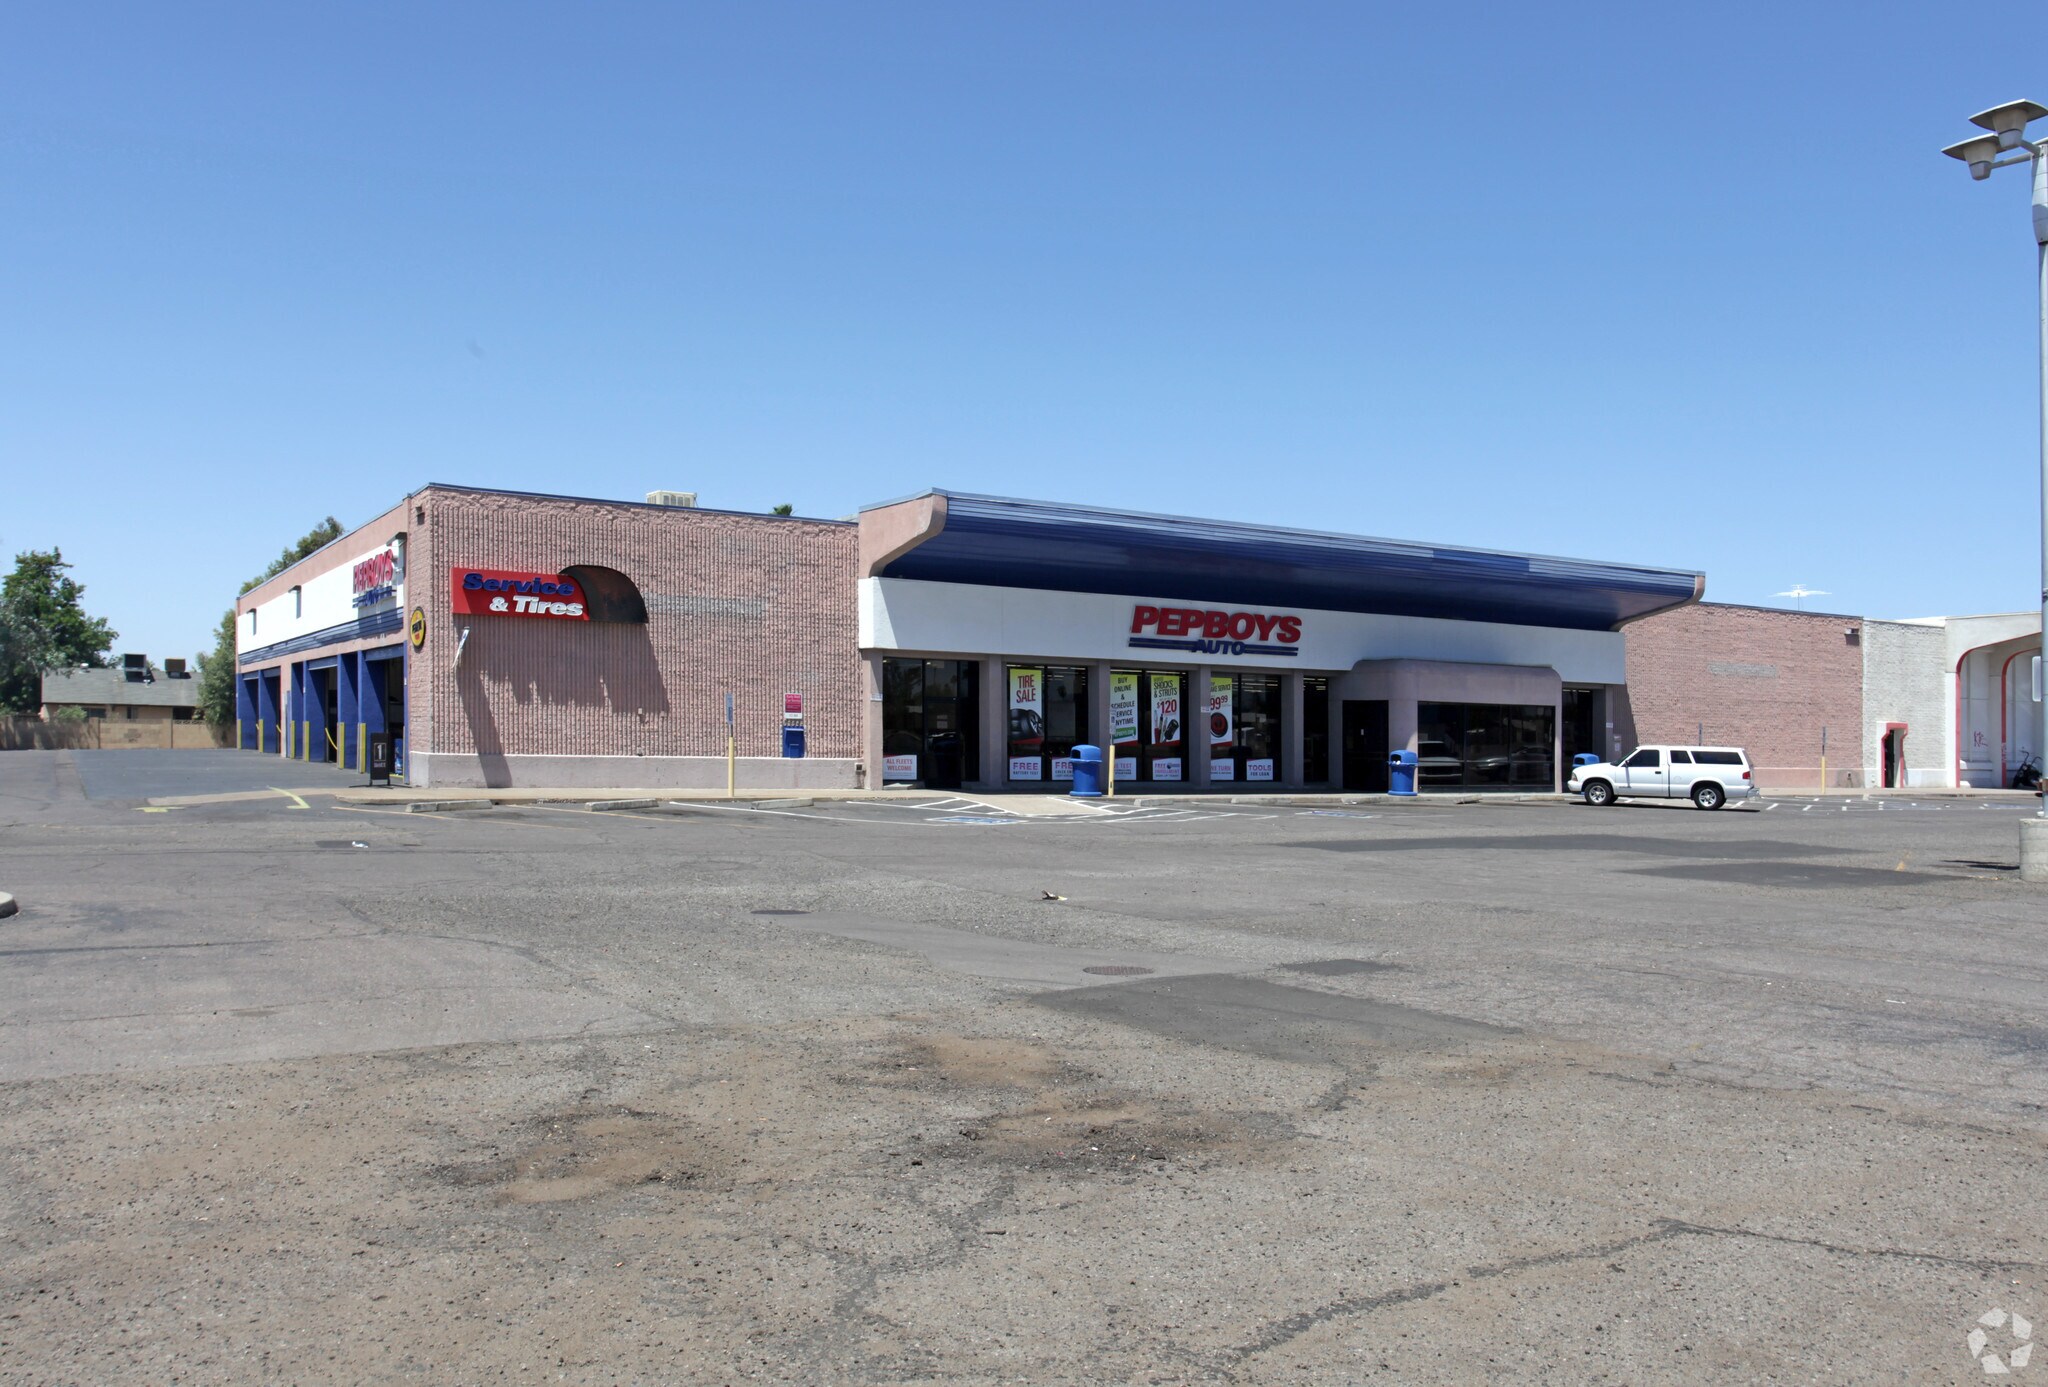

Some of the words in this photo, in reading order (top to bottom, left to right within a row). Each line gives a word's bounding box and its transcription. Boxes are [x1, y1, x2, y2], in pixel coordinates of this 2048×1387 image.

[353, 549, 394, 594] PEPBOYS
[463, 572, 574, 595] Service
[489, 596, 508, 612] &
[513, 595, 583, 616] Tires
[1131, 605, 1302, 643] PEPBOYS
[1190, 639, 1246, 655] AUTO
[1017, 674, 1035, 689] TIRE
[1114, 684, 1132, 693] ONLINE
[1154, 680, 1173, 690] SHOCKS
[1016, 688, 1036, 704] SALE
[1154, 690, 1158, 698] &
[1159, 688, 1178, 698] STRUTS
[1116, 709, 1133, 718] ERVICE
[1157, 699, 1177, 714] $120
[1115, 717, 1134, 726] NYTIME
[377, 744, 382, 760] 1
[1013, 762, 1039, 770] FREE
